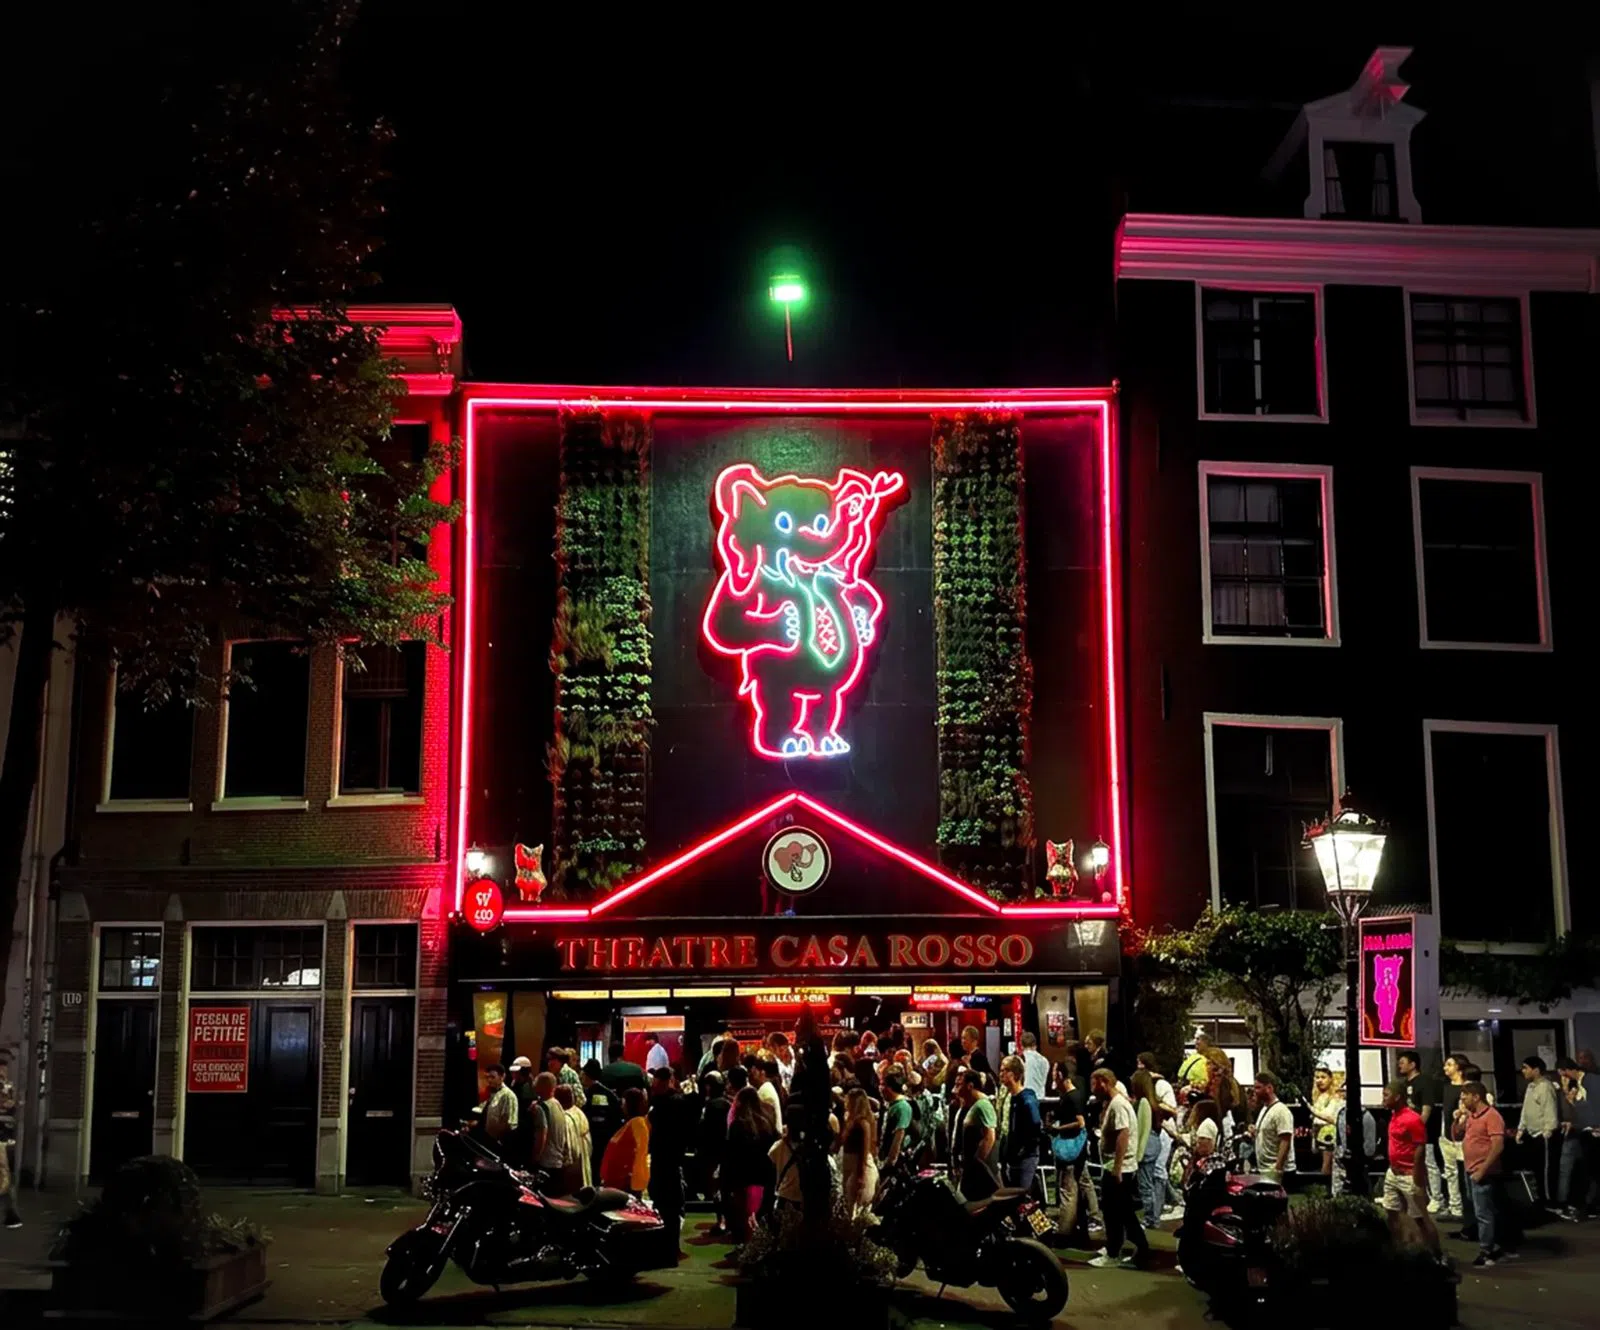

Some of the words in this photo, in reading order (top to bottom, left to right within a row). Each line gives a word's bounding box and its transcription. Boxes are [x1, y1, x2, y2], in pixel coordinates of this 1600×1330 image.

[554, 935, 758, 970] THEATRE
[771, 935, 878, 968] CASA
[887, 934, 1033, 967] ROSSO
